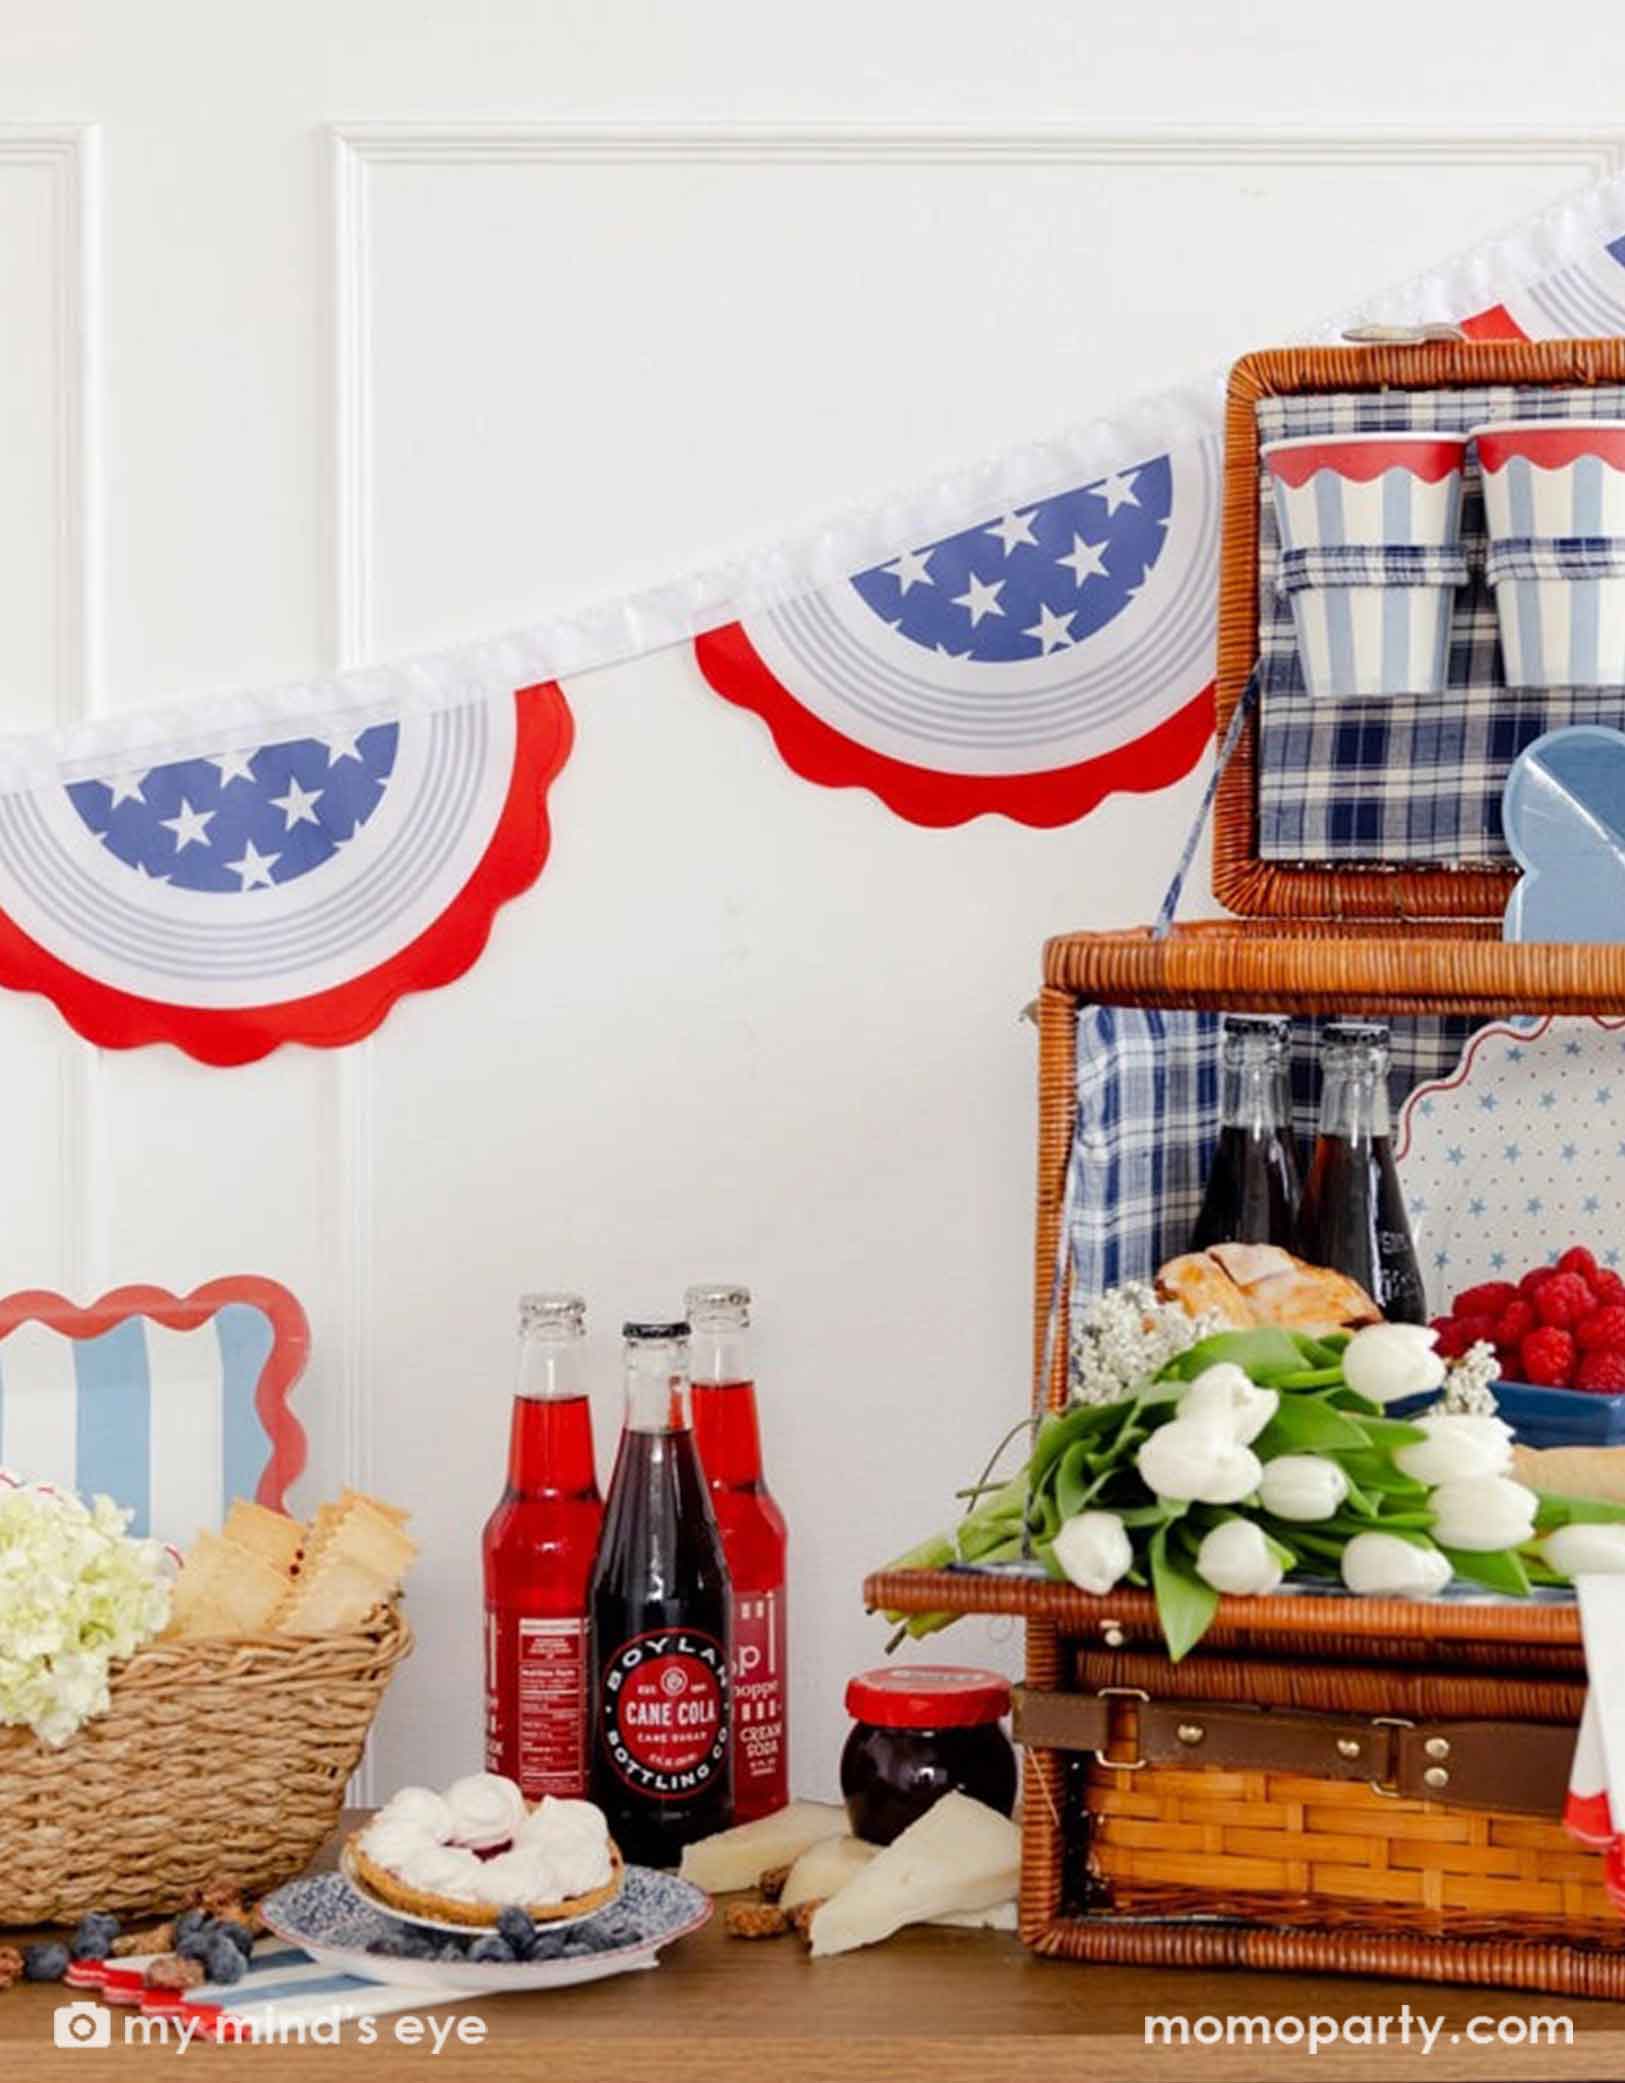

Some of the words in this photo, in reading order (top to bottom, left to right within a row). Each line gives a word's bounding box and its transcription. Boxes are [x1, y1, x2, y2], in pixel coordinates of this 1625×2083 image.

[606, 1636, 729, 1692] BOYLAN
[625, 1701, 673, 1727] CANE
[677, 1699, 717, 1725] COLA
[607, 1729, 710, 1790] BOTTLING
